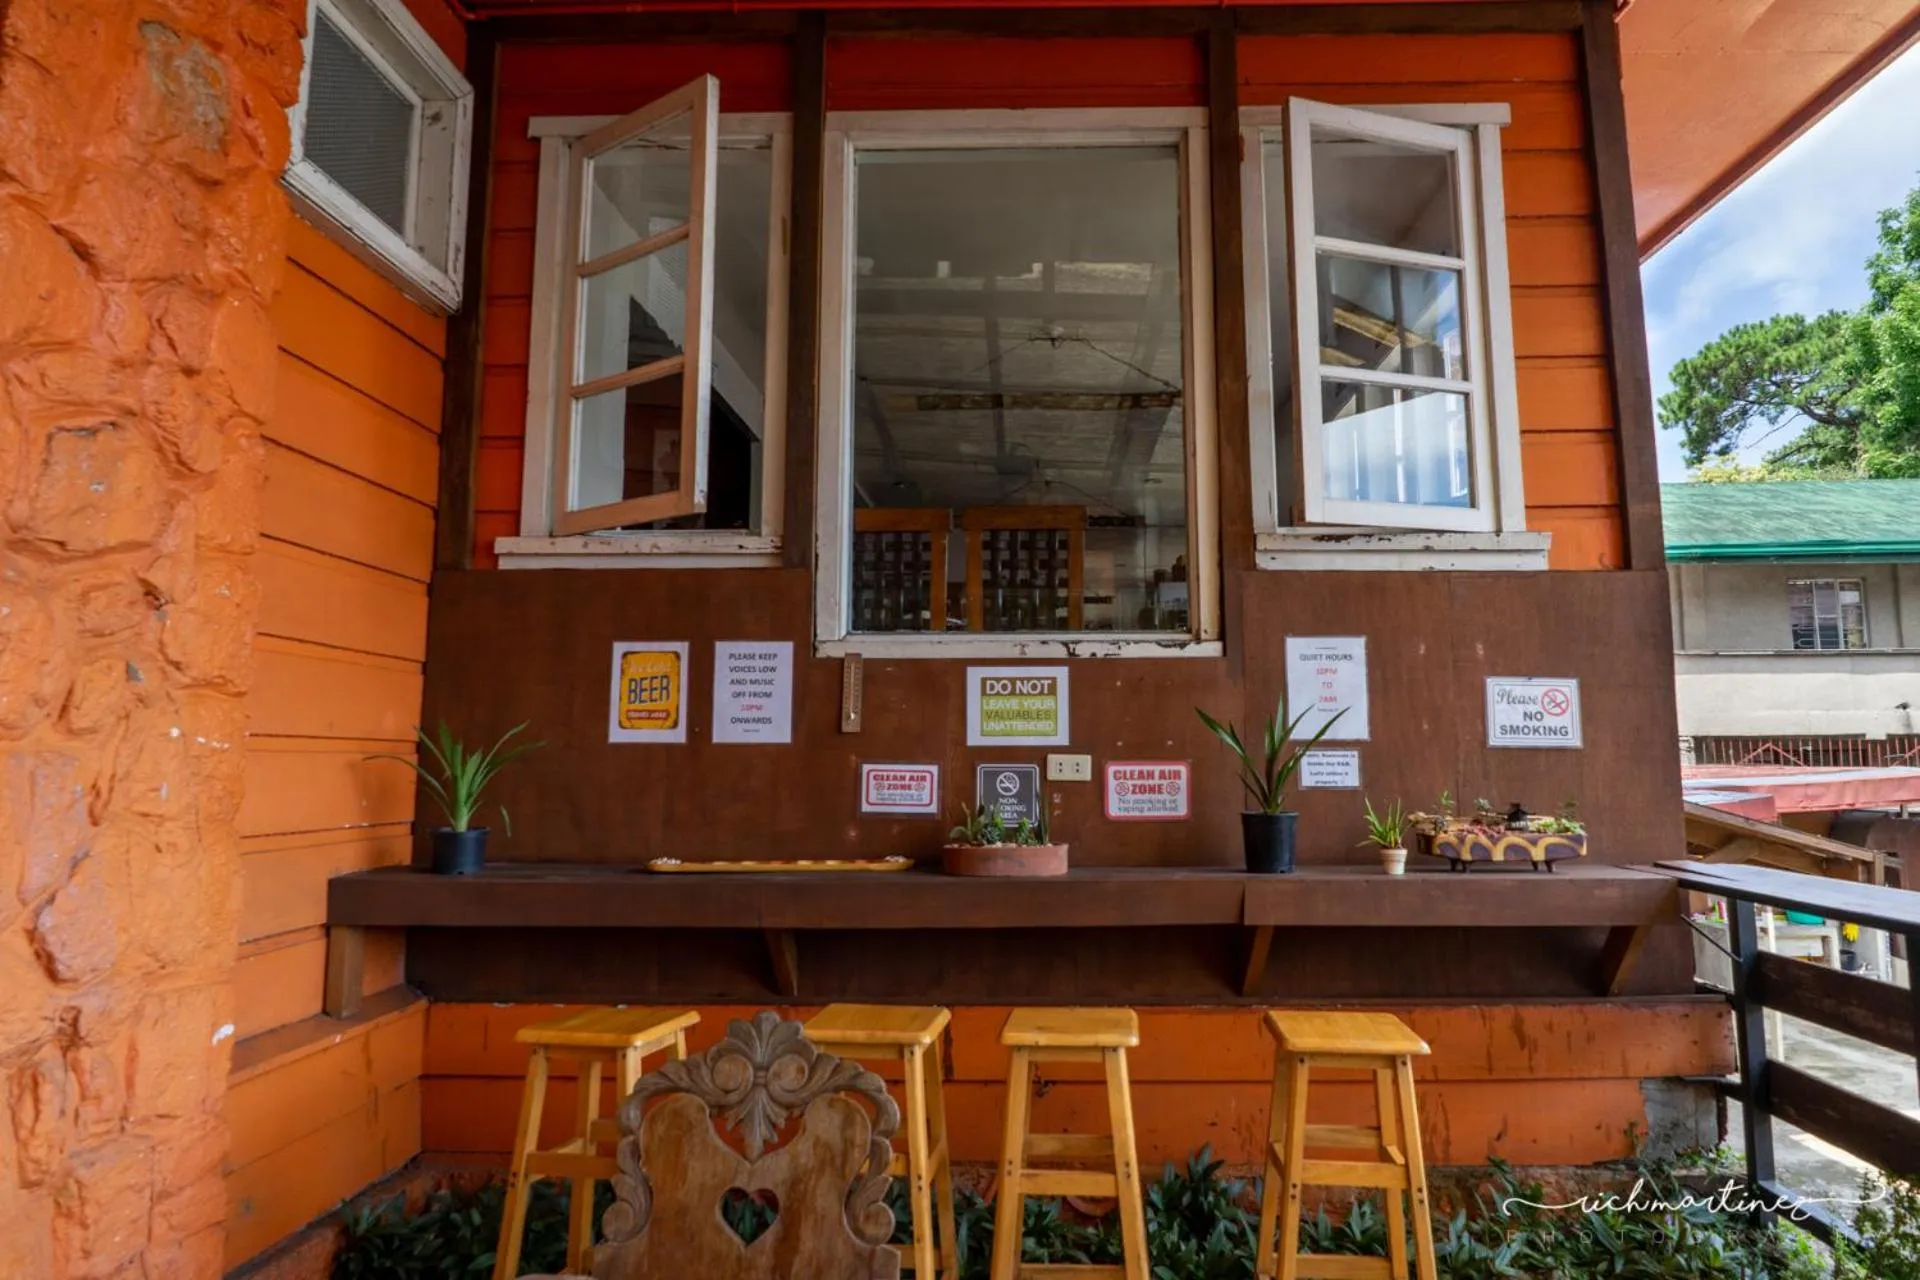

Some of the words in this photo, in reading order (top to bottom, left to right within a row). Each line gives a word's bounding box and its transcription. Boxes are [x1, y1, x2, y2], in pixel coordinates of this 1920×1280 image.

[627, 674, 671, 705] BEER
[986, 679, 1012, 695] DO
[1015, 679, 1052, 695] NOT
[1496, 687, 1540, 705] Please
[983, 698, 1018, 709] LEAVE
[1023, 698, 1055, 709] YOUR
[730, 716, 773, 724] ONWARDS
[986, 711, 1052, 720] VALUABLES
[1523, 710, 1545, 722] NO
[1499, 724, 1569, 737] SMOKING
[873, 774, 907, 782] CLEAN
[908, 774, 927, 782] AIR
[1113, 769, 1155, 780] CLEAN
[1159, 769, 1181, 780] AIR
[886, 783, 913, 791] ZONE
[1131, 783, 1165, 795] ZONE
